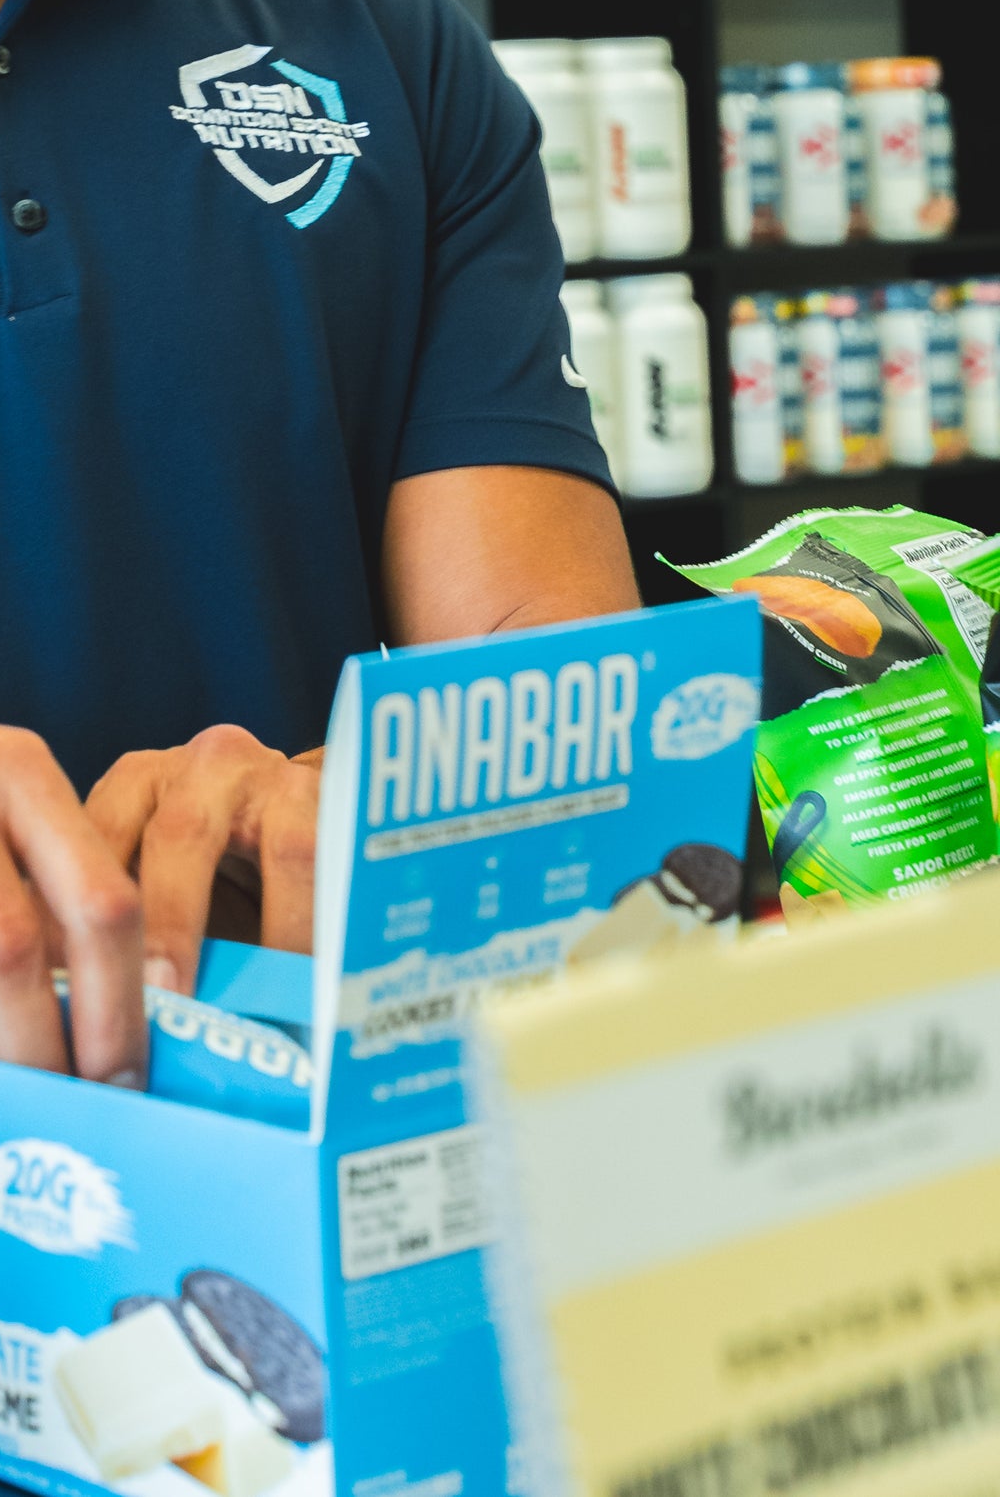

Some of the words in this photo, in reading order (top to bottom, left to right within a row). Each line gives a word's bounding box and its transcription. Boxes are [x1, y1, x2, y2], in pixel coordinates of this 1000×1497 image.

[214, 80, 313, 117] DSN
[193, 124, 362, 157] NUTRITION
[289, 117, 370, 138] SPORTS
[904, 543, 944, 563] Nutrition
[940, 536, 968, 551] Facts
[808, 718, 843, 736] WILDE
[844, 715, 856, 728] IS
[854, 709, 874, 724] THE
[825, 737, 841, 750] TO
[843, 728, 877, 746] CRAFT
[930, 706, 951, 720] FROM
[367, 653, 638, 826] ANABAR
[853, 746, 884, 762] 100%
[883, 738, 917, 754] NATURAL
[833, 773, 858, 787] OUR
[857, 764, 888, 781] SPICY
[888, 756, 917, 773] QUESO
[915, 748, 943, 764] BLENDS
[958, 739, 969, 751] OF
[843, 785, 889, 804] SMOKED
[889, 773, 930, 792] CHIPOTLE
[929, 768, 945, 780] AND
[944, 758, 975, 774] ROASTED
[896, 795, 923, 811] WITH
[921, 794, 929, 804] A
[927, 782, 963, 801] DELICIOUS
[850, 826, 880, 843] AGED
[881, 814, 928, 835] CHEDDAR
[868, 841, 905, 858] FIESTA
[905, 835, 926, 851] FOR
[926, 828, 947, 843] YOUR
[892, 855, 945, 882] SAVOR
[5, 1150, 76, 1213] 20G
